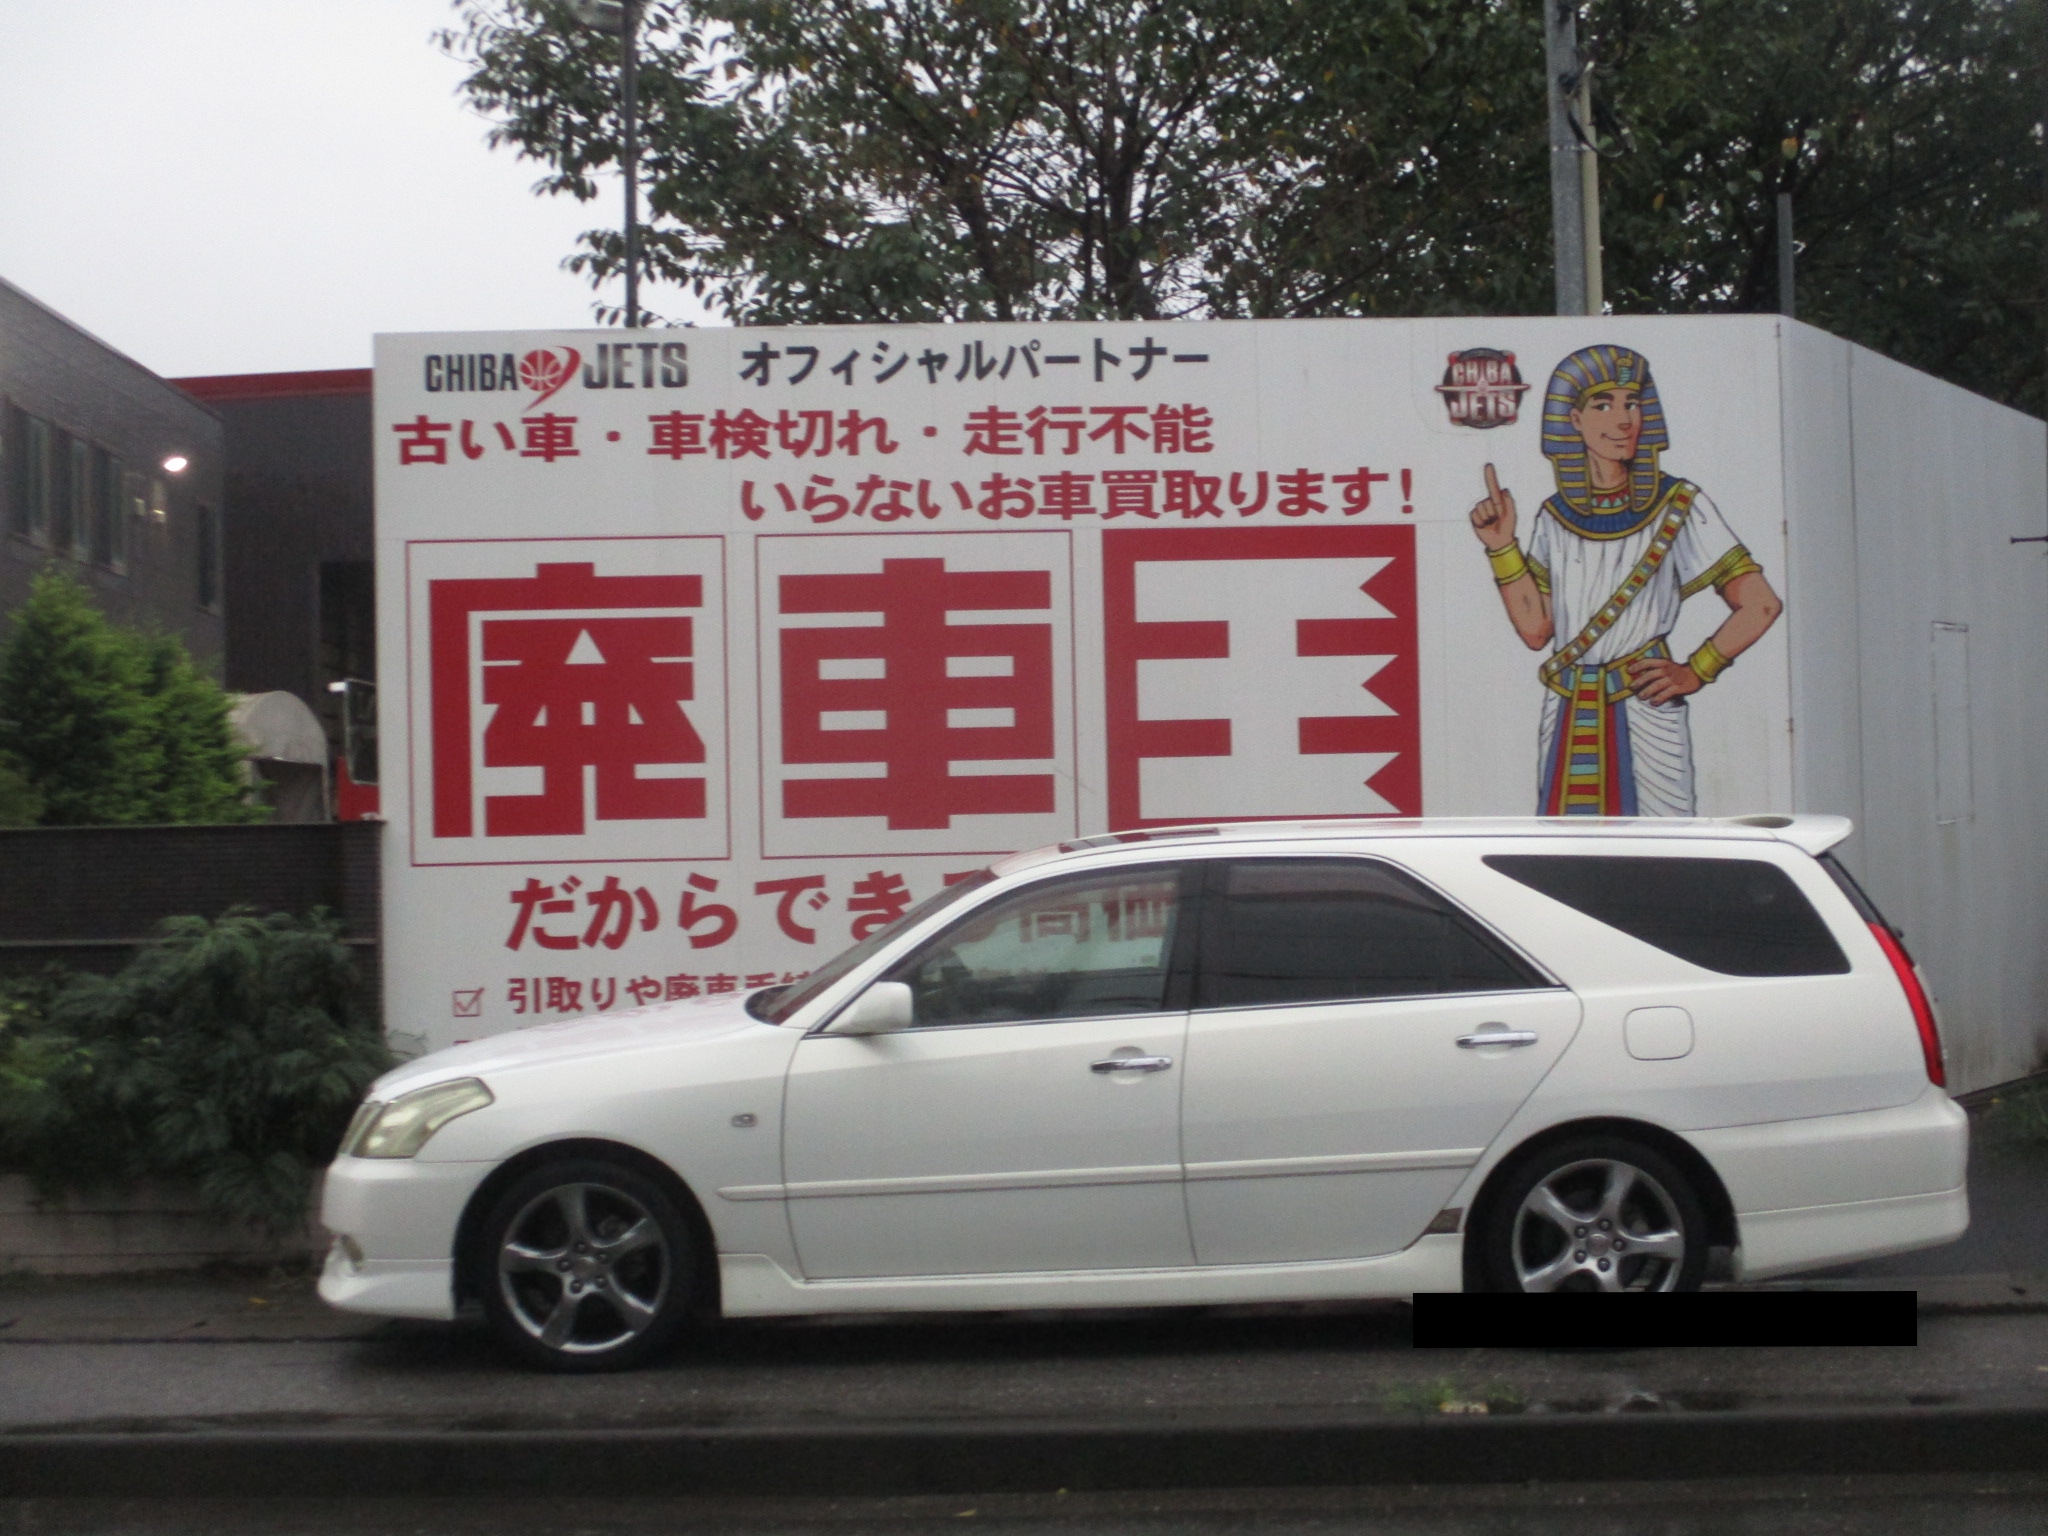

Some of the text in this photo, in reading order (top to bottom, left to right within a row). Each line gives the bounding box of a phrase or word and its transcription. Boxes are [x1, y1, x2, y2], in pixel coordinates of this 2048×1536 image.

[424, 342, 688, 392] CHIBA JETS
[739, 339, 1210, 386] オフィシャルパートナー
[1449, 391, 1518, 420] JETS
